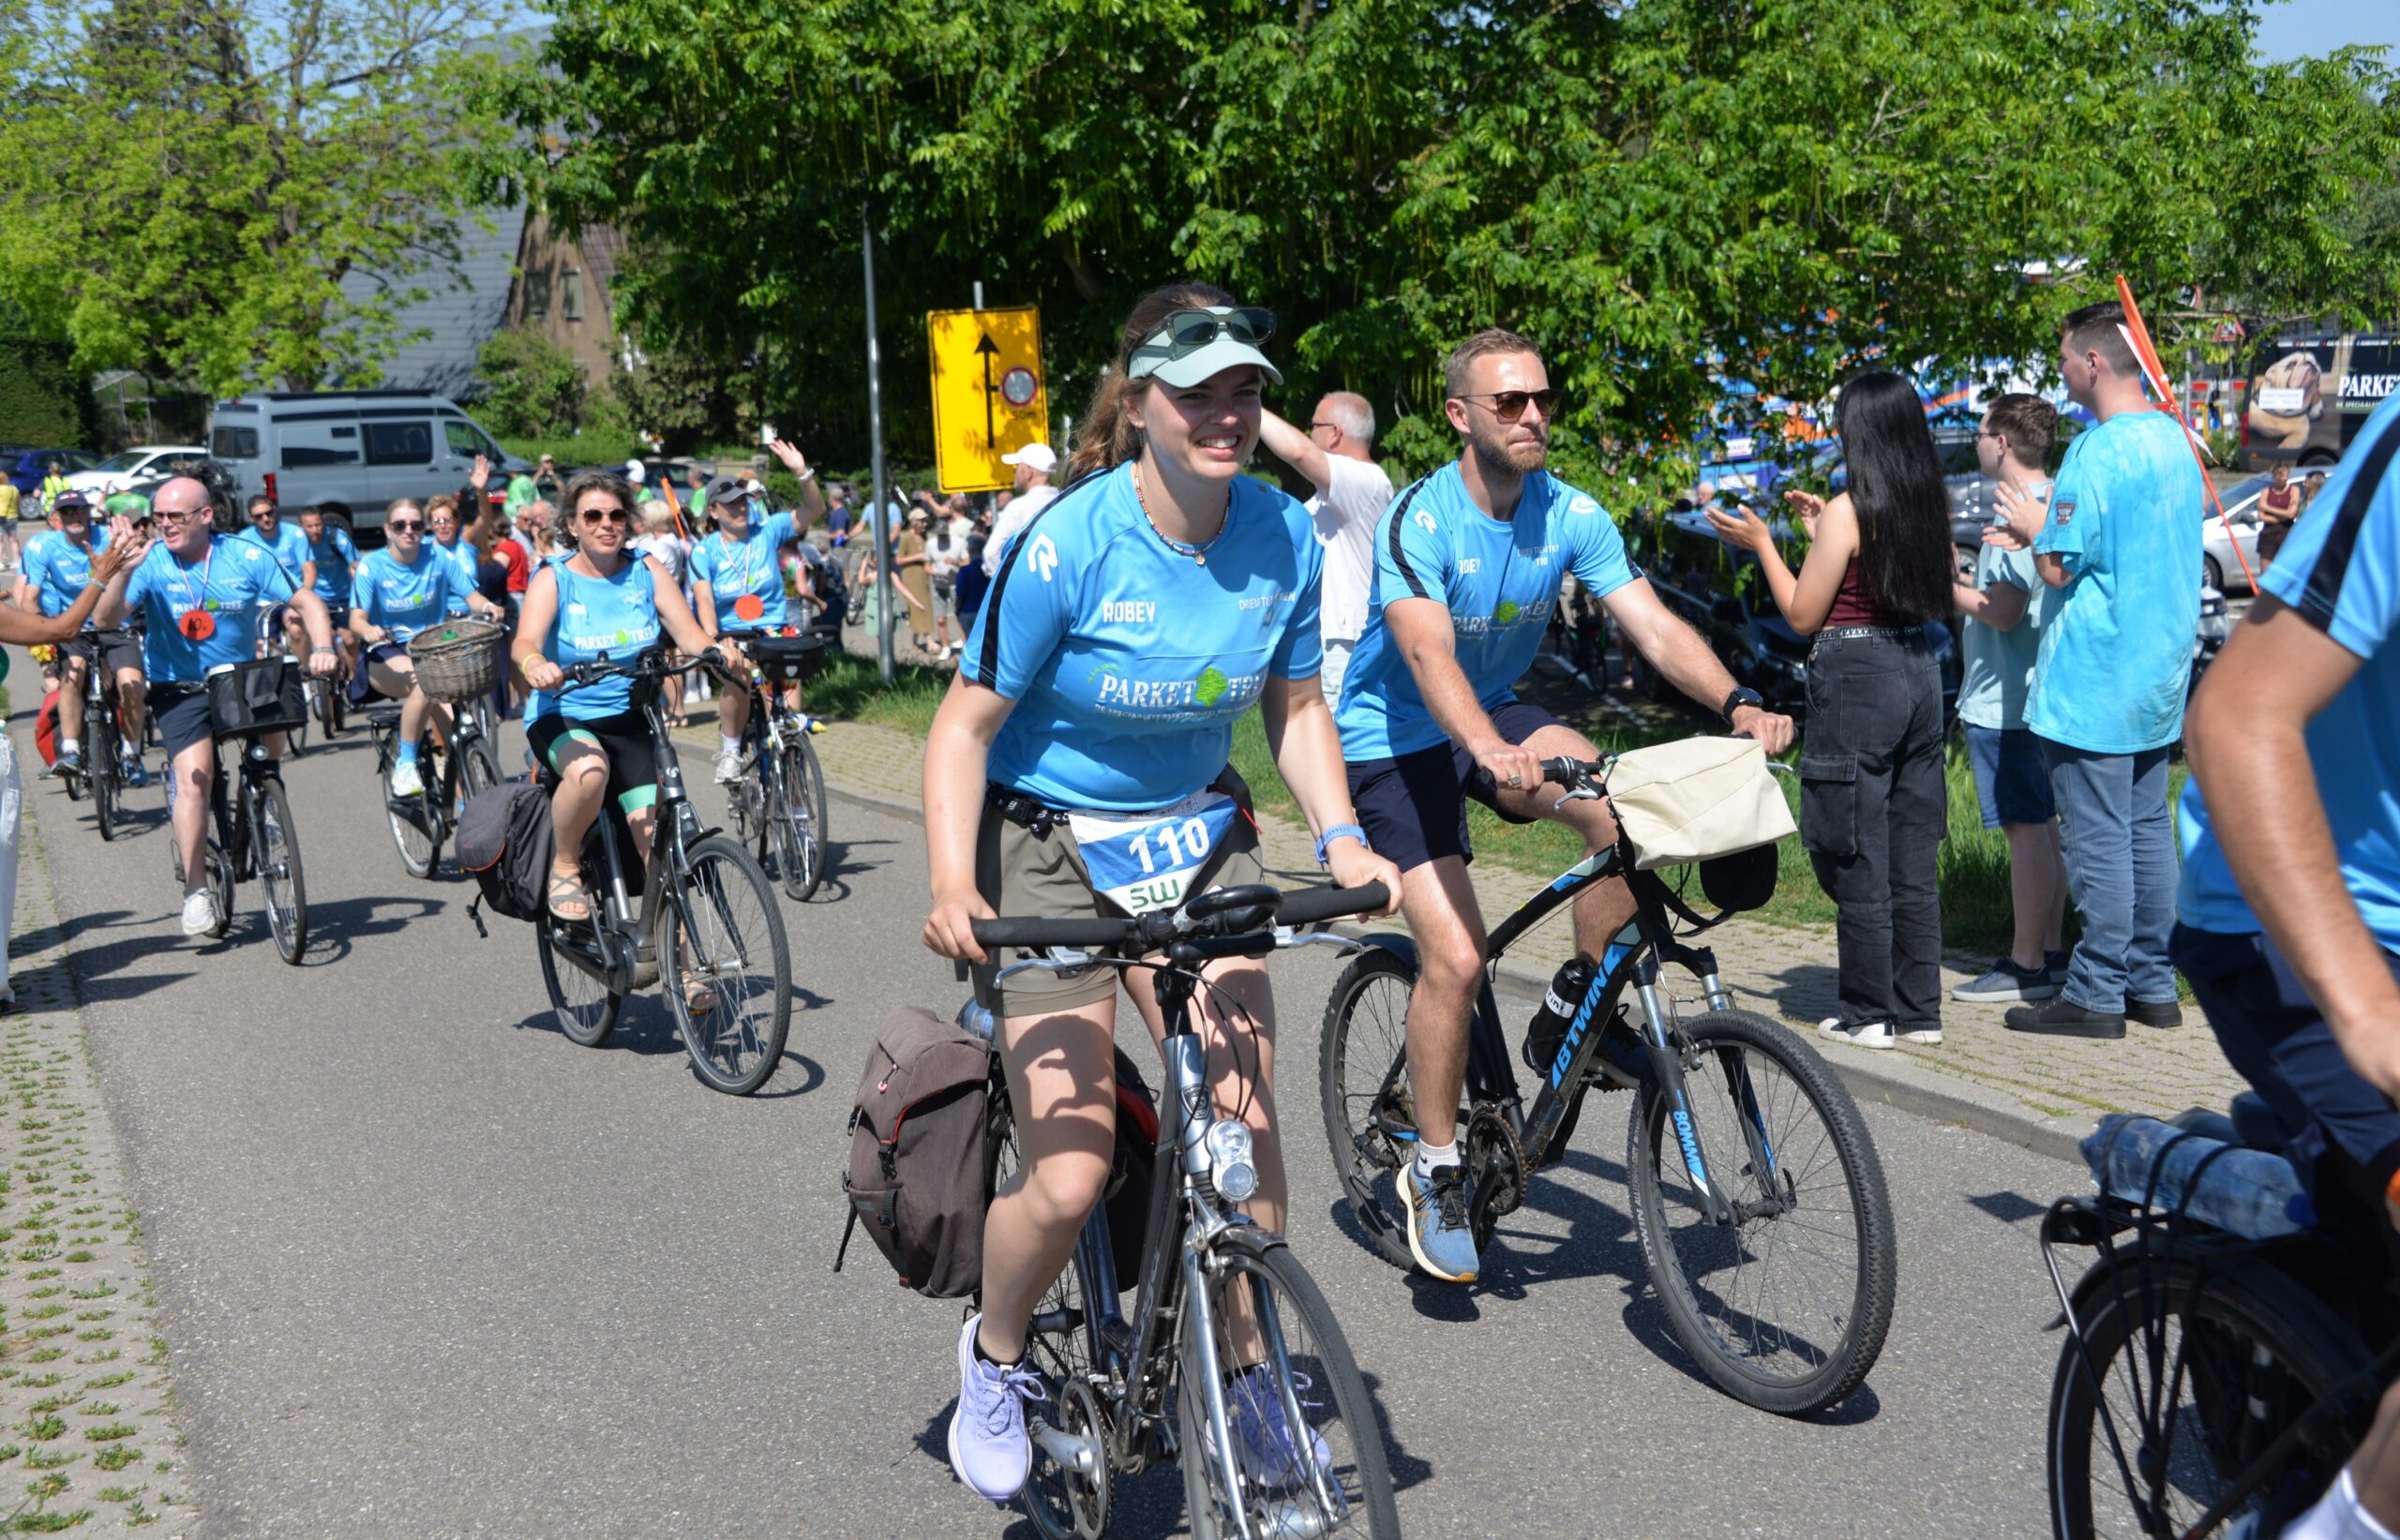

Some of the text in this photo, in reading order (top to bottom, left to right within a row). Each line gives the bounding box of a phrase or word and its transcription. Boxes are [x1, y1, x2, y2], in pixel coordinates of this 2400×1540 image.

[2337, 374, 2400, 396] PARKE
[1103, 601, 1155, 622] ROBEY
[575, 635, 616, 650] PARKET
[1097, 673, 1197, 708] PARKET
[1129, 817, 1209, 874] 110
